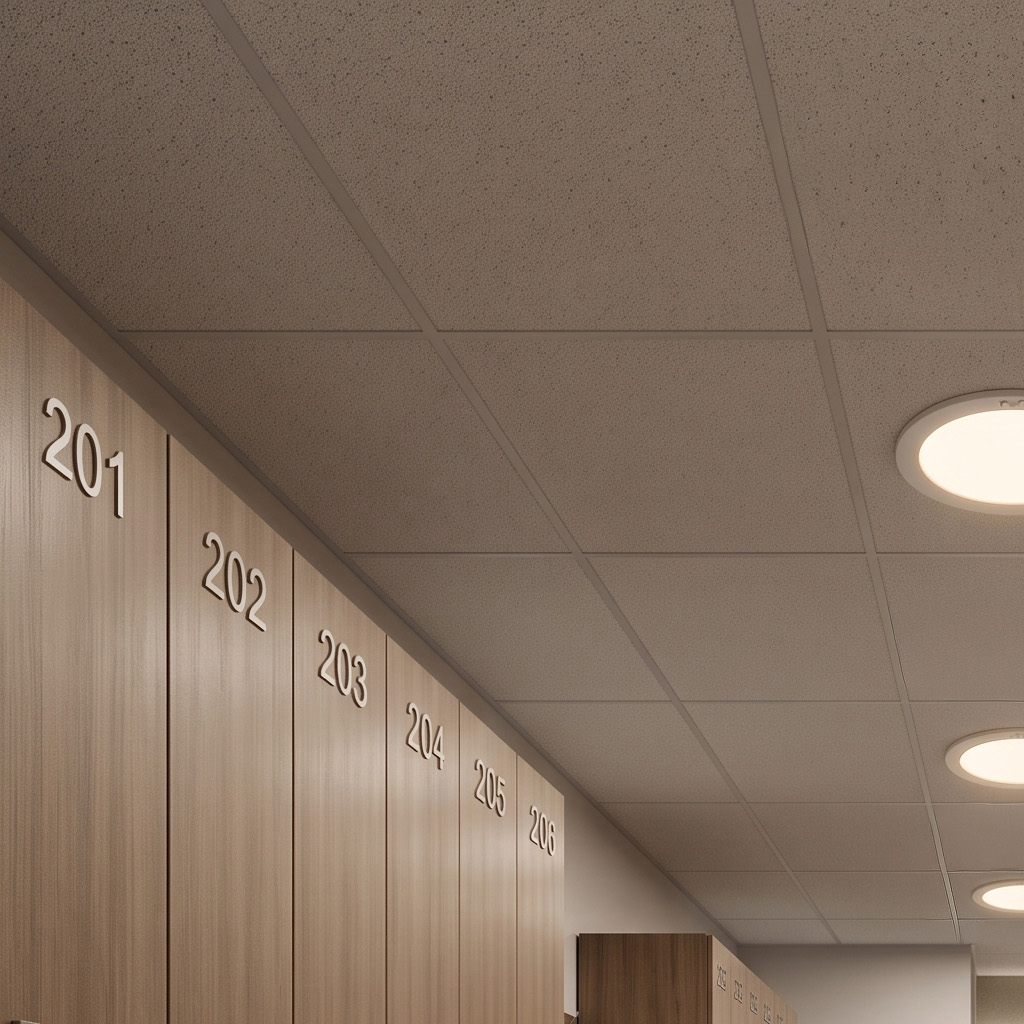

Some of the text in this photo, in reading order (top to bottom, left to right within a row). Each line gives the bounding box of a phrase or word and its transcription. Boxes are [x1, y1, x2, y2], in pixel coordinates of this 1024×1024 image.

[42, 397, 124, 518] 201
[202, 531, 267, 632] 202
[318, 629, 367, 708] 203
[406, 702, 445, 770] 204
[474, 759, 506, 817] 205
[530, 805, 556, 857] 206
